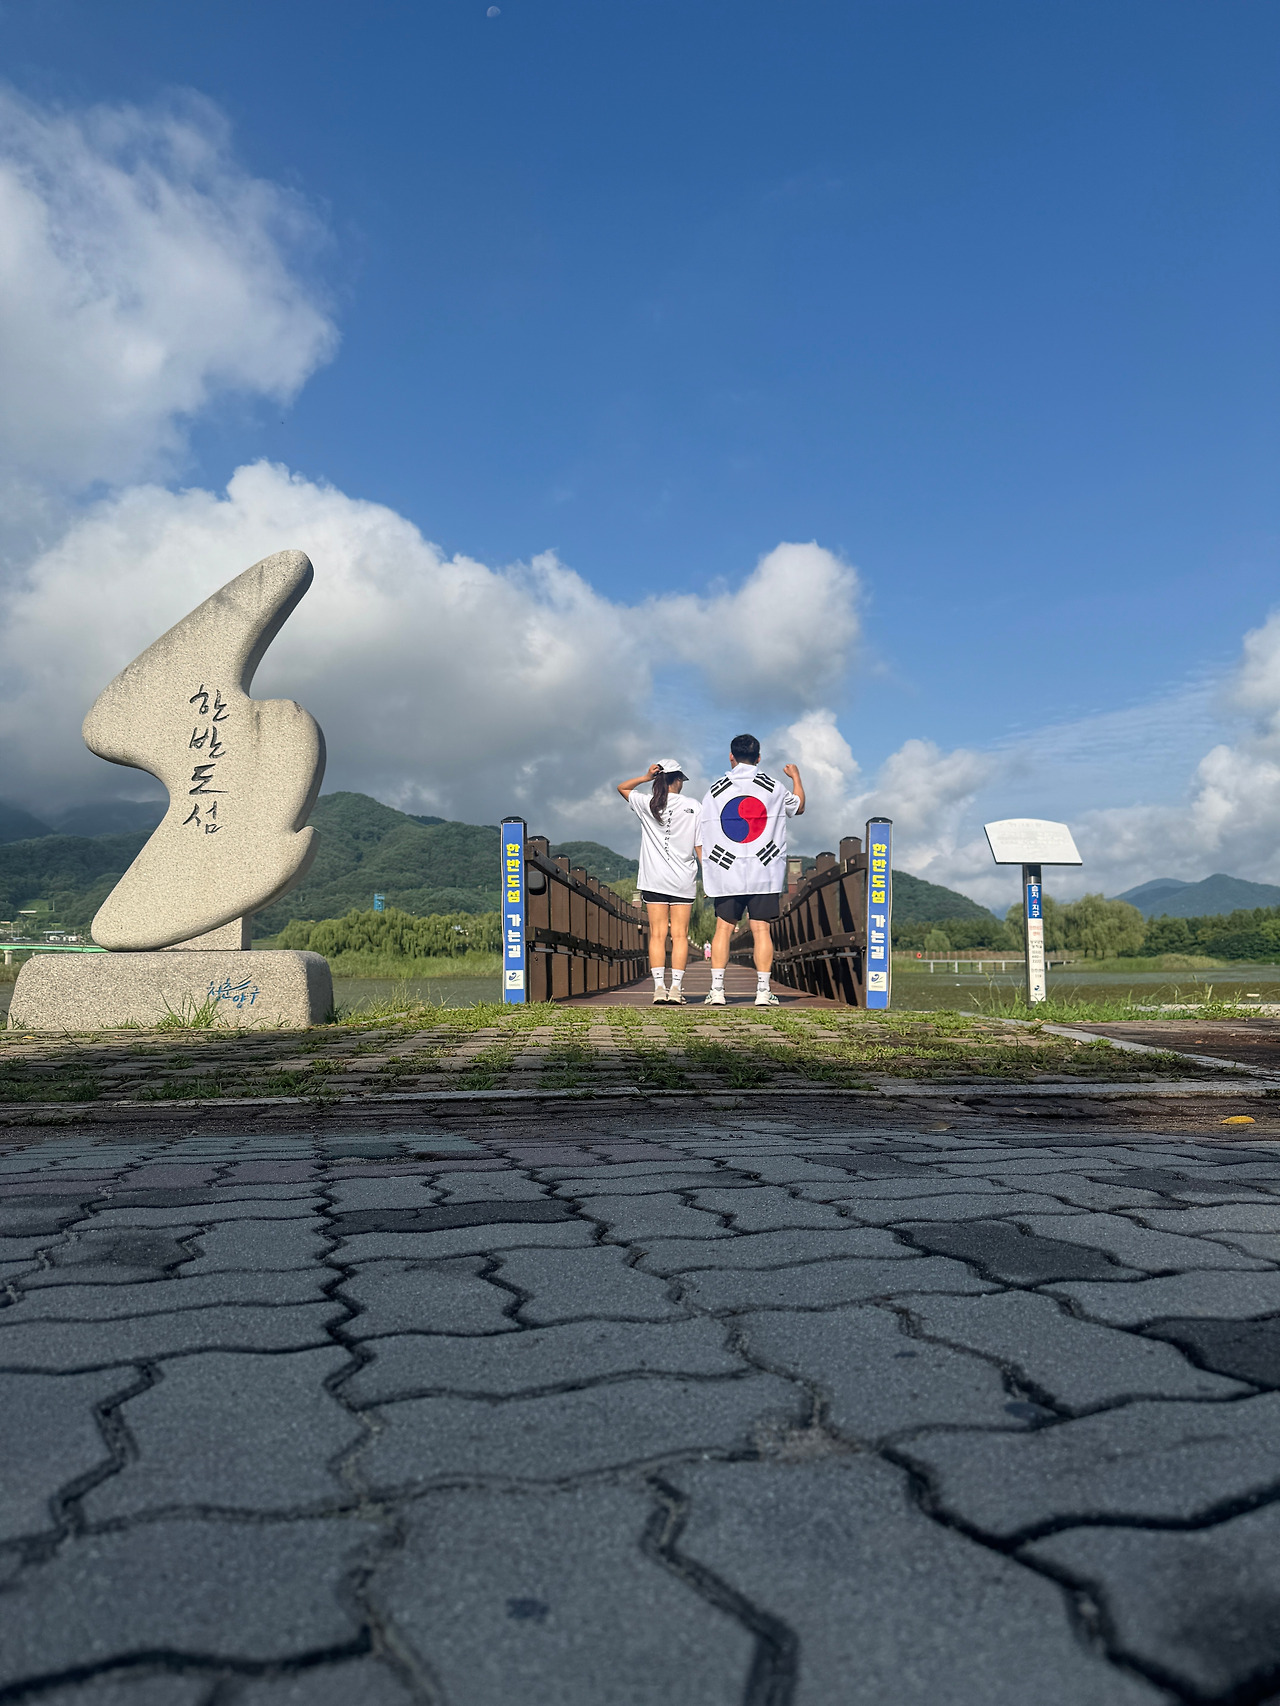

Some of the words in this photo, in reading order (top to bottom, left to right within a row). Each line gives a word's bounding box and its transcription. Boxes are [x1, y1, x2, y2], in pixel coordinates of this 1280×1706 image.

[183, 684, 230, 834] 한반도섬
[506, 843, 521, 903] 한반도섬
[871, 843, 887, 904] 한반도섬
